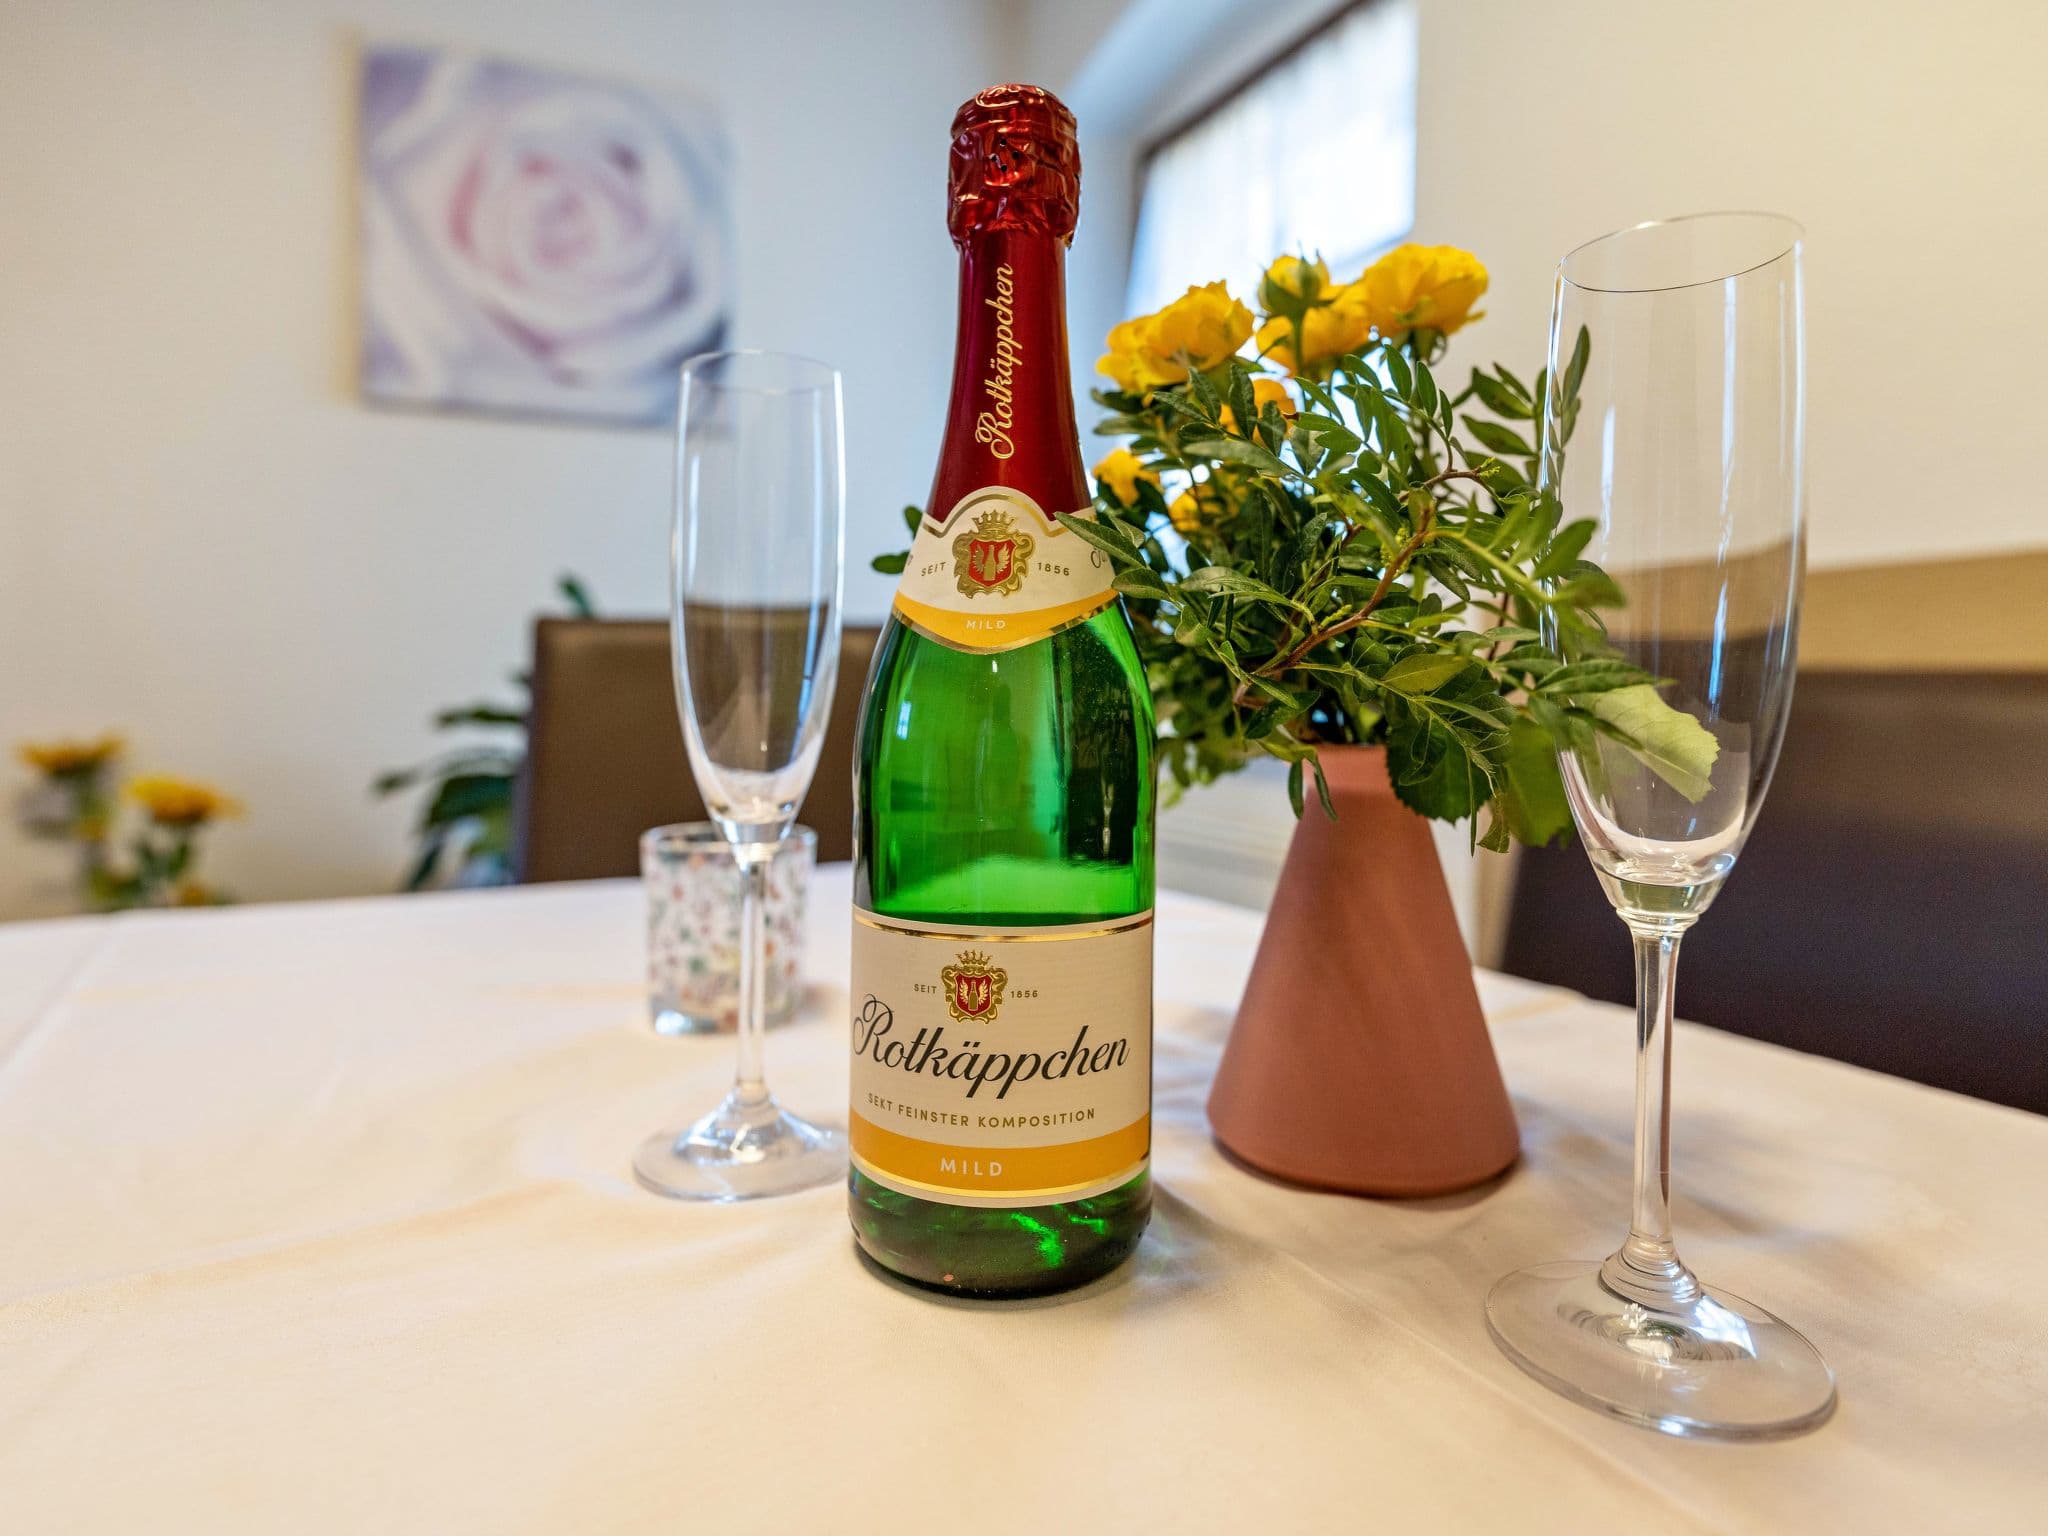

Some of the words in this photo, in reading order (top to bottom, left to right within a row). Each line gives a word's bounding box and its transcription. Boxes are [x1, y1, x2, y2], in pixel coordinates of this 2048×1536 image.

[975, 263, 1023, 460] Rotkäppchen
[921, 561, 947, 577] SEIT
[1037, 562, 1071, 576] 1856
[966, 619, 1007, 630] MILD
[914, 983, 937, 994] SEIT
[1011, 990, 1039, 999] 1856
[853, 993, 1131, 1100] Rotkäppchen
[868, 1092, 893, 1112] SEKT
[898, 1104, 969, 1127] FEINSTER
[978, 1108, 1096, 1128] KOMPOSITION
[940, 1157, 1003, 1177] MILD
